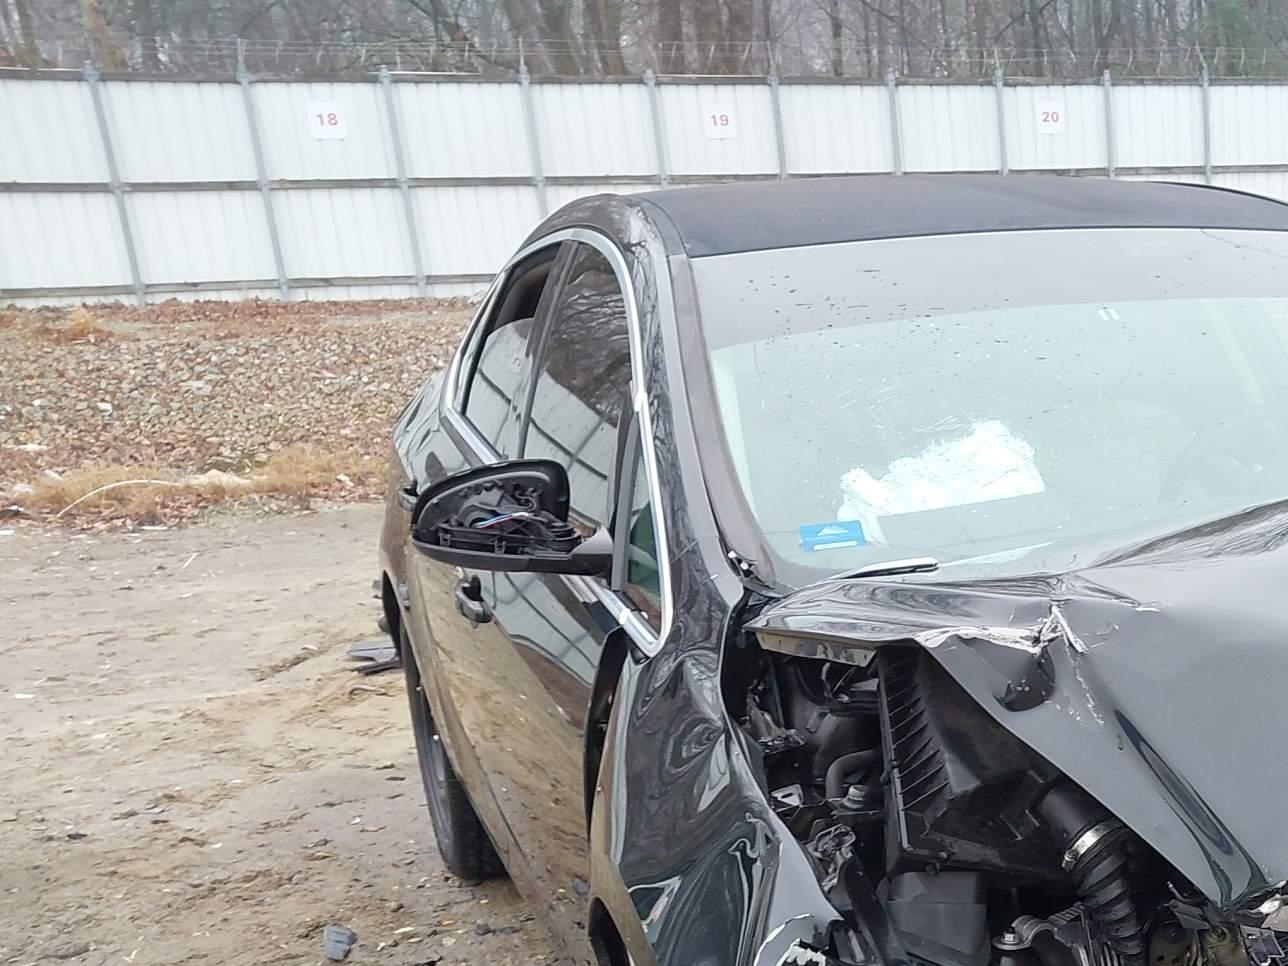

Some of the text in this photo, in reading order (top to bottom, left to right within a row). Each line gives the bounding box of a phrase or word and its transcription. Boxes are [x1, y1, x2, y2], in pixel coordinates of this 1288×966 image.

[315, 112, 339, 126] 18
[710, 114, 729, 127] 19
[1042, 111, 1060, 123] 20
